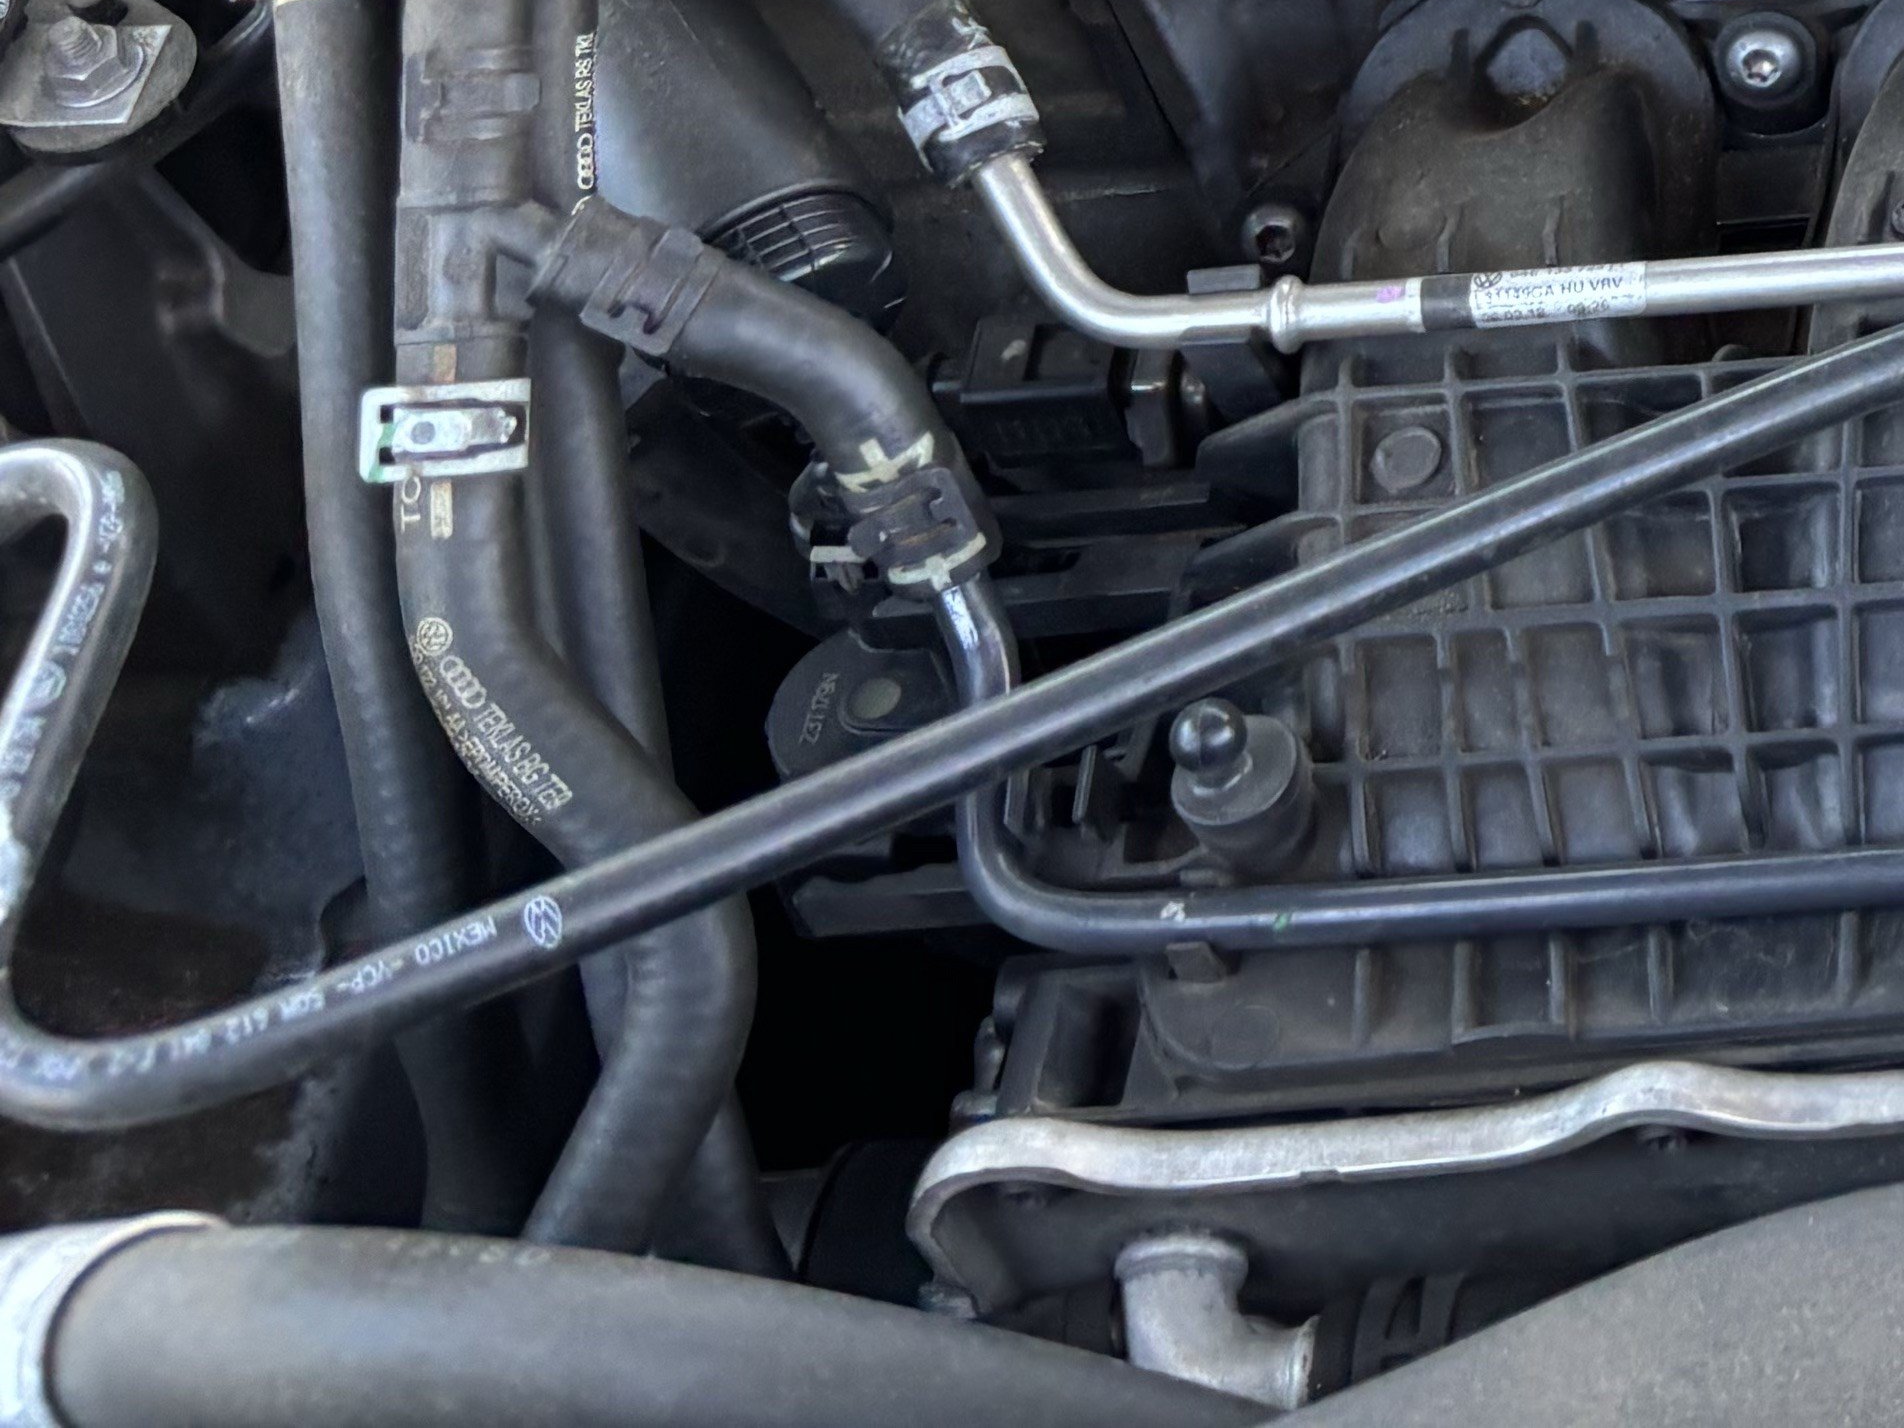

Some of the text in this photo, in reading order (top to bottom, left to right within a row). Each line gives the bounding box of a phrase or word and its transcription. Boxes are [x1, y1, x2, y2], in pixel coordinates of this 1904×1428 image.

[574, 80, 592, 131] TEKLAS
[473, 703, 531, 764] TEKLAS
[414, 918, 497, 964] MEXICO
